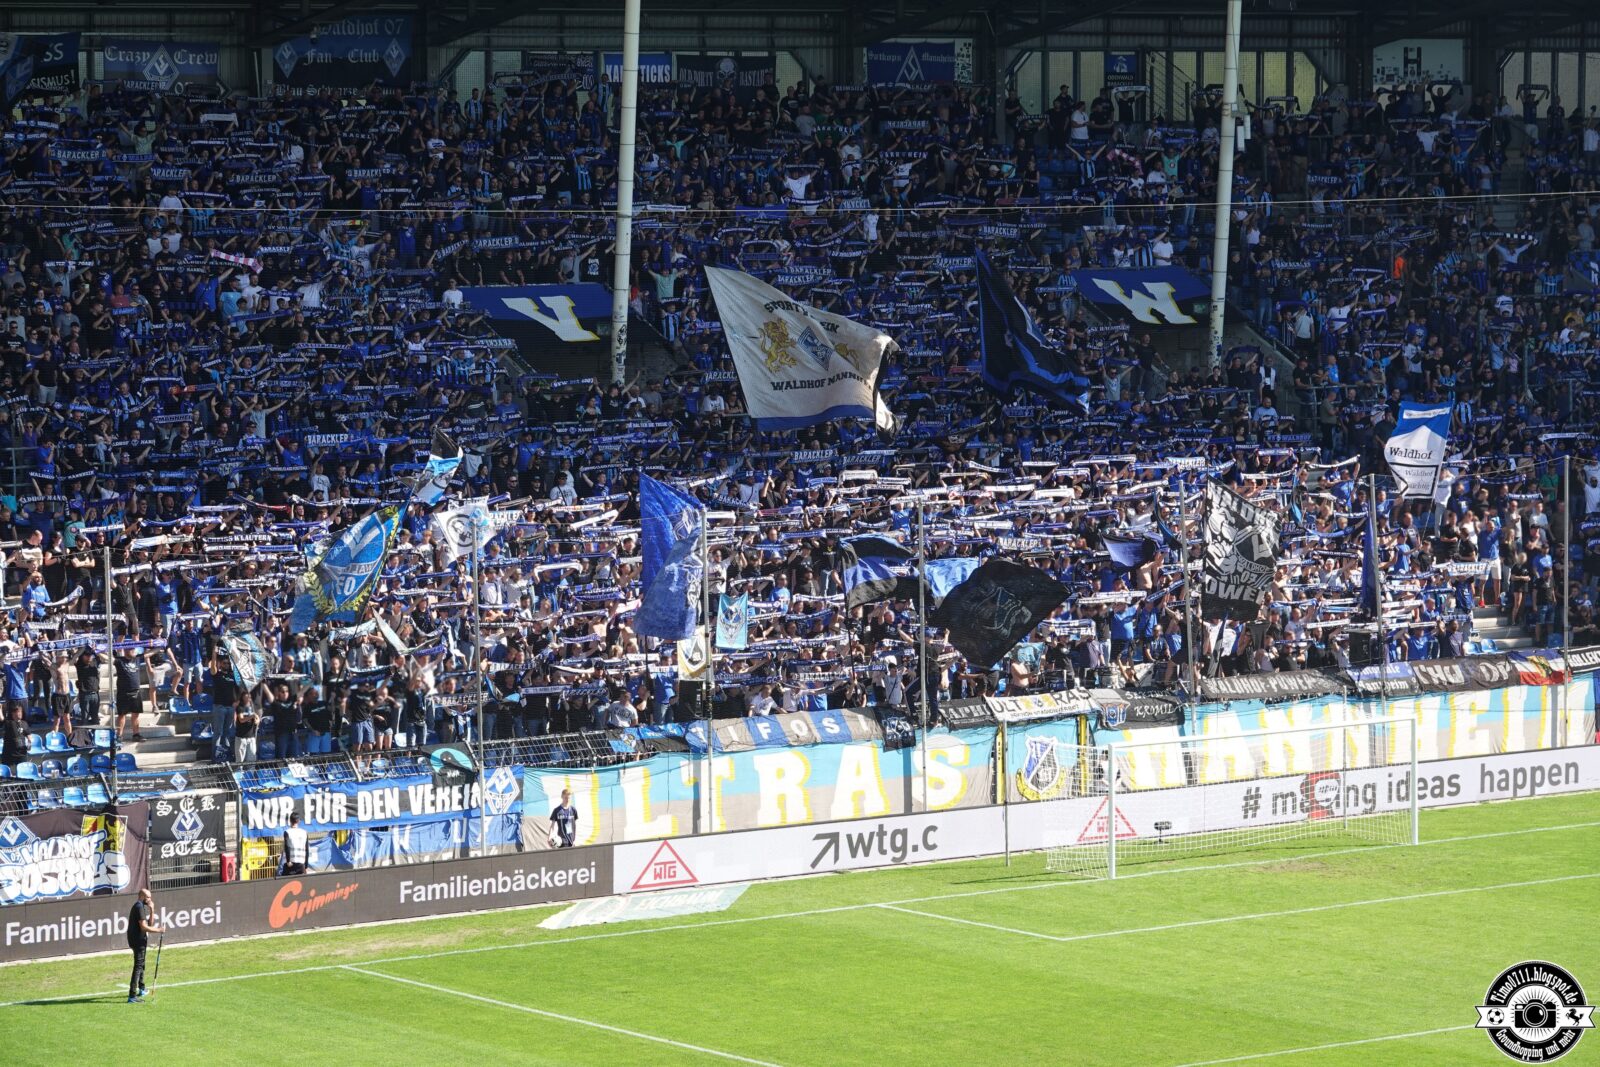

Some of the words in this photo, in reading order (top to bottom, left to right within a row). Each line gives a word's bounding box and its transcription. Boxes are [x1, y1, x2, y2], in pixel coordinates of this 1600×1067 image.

[385, 18, 404, 36] 07
[105, 46, 150, 66] Crazy
[174, 48, 217, 65] Crew
[303, 49, 333, 66] Fan
[348, 49, 380, 63] Club
[695, 70, 714, 87] DIRTY
[57, 150, 100, 161] BARACKLER
[236, 174, 277, 184] BARACKLER
[770, 378, 826, 391] WALDHOF
[308, 433, 349, 445] BARACKLER
[794, 450, 834, 462] BARACKLER
[843, 455, 883, 466] BARACKLER
[1388, 446, 1433, 460] Waldhof
[1404, 469, 1433, 477] Waldhof
[1052, 686, 1092, 706] RAS
[541, 733, 971, 845] ULTRAS
[1387, 771, 1461, 804] ideas
[1480, 761, 1580, 798] happen
[247, 796, 294, 830] NUR
[304, 788, 348, 825] FÜR
[358, 786, 400, 822] DEN
[20, 830, 107, 865] WALDHOF
[161, 837, 218, 859] ATZE
[845, 823, 939, 864] wtg.c
[653, 860, 677, 881] WTG
[5, 901, 222, 946] Familienbckerei
[268, 880, 359, 929] Grimminger
[400, 861, 596, 904] Familienbäckerei
